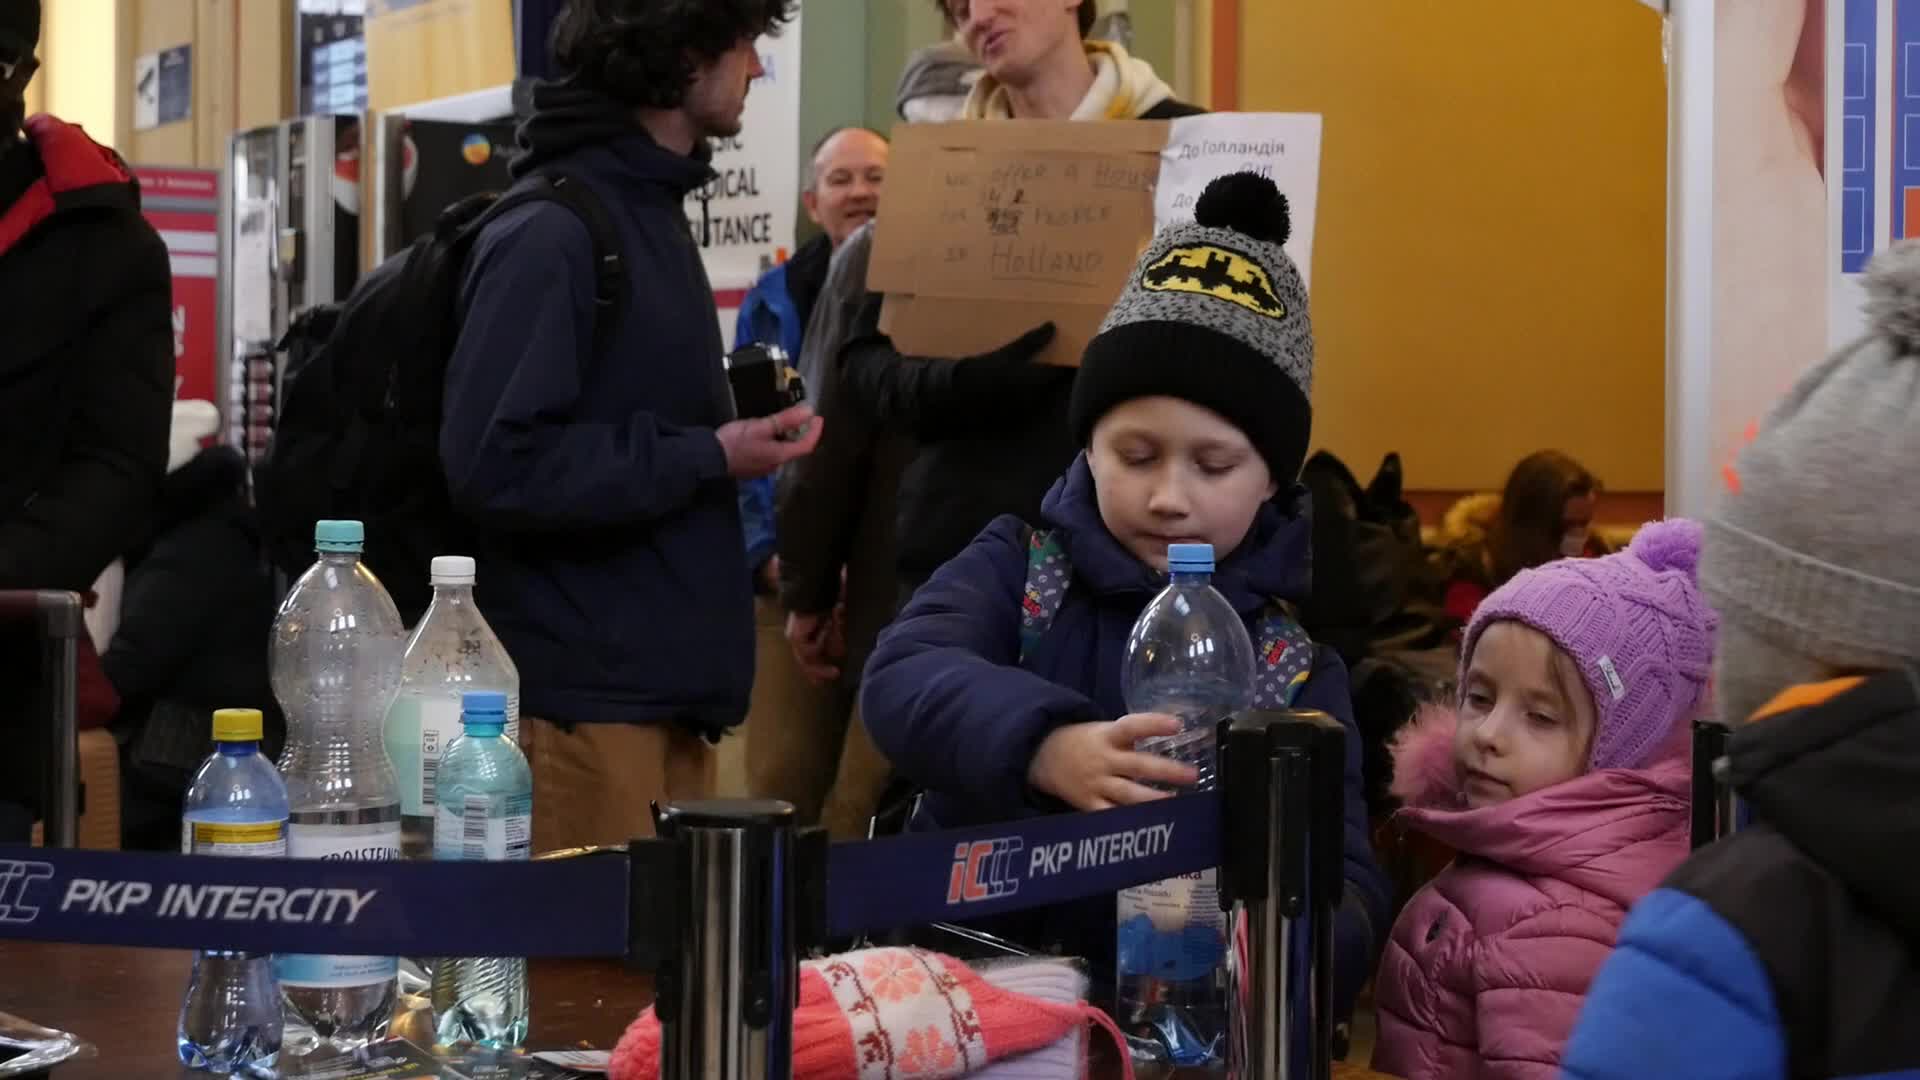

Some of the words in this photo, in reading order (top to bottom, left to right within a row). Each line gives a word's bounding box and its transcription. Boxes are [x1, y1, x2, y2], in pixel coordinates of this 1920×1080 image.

[1028, 842, 1072, 878] PKP
[1076, 822, 1175, 869] INTERCITY
[61, 879, 152, 914] PKP
[156, 884, 376, 924] INTERCITY
